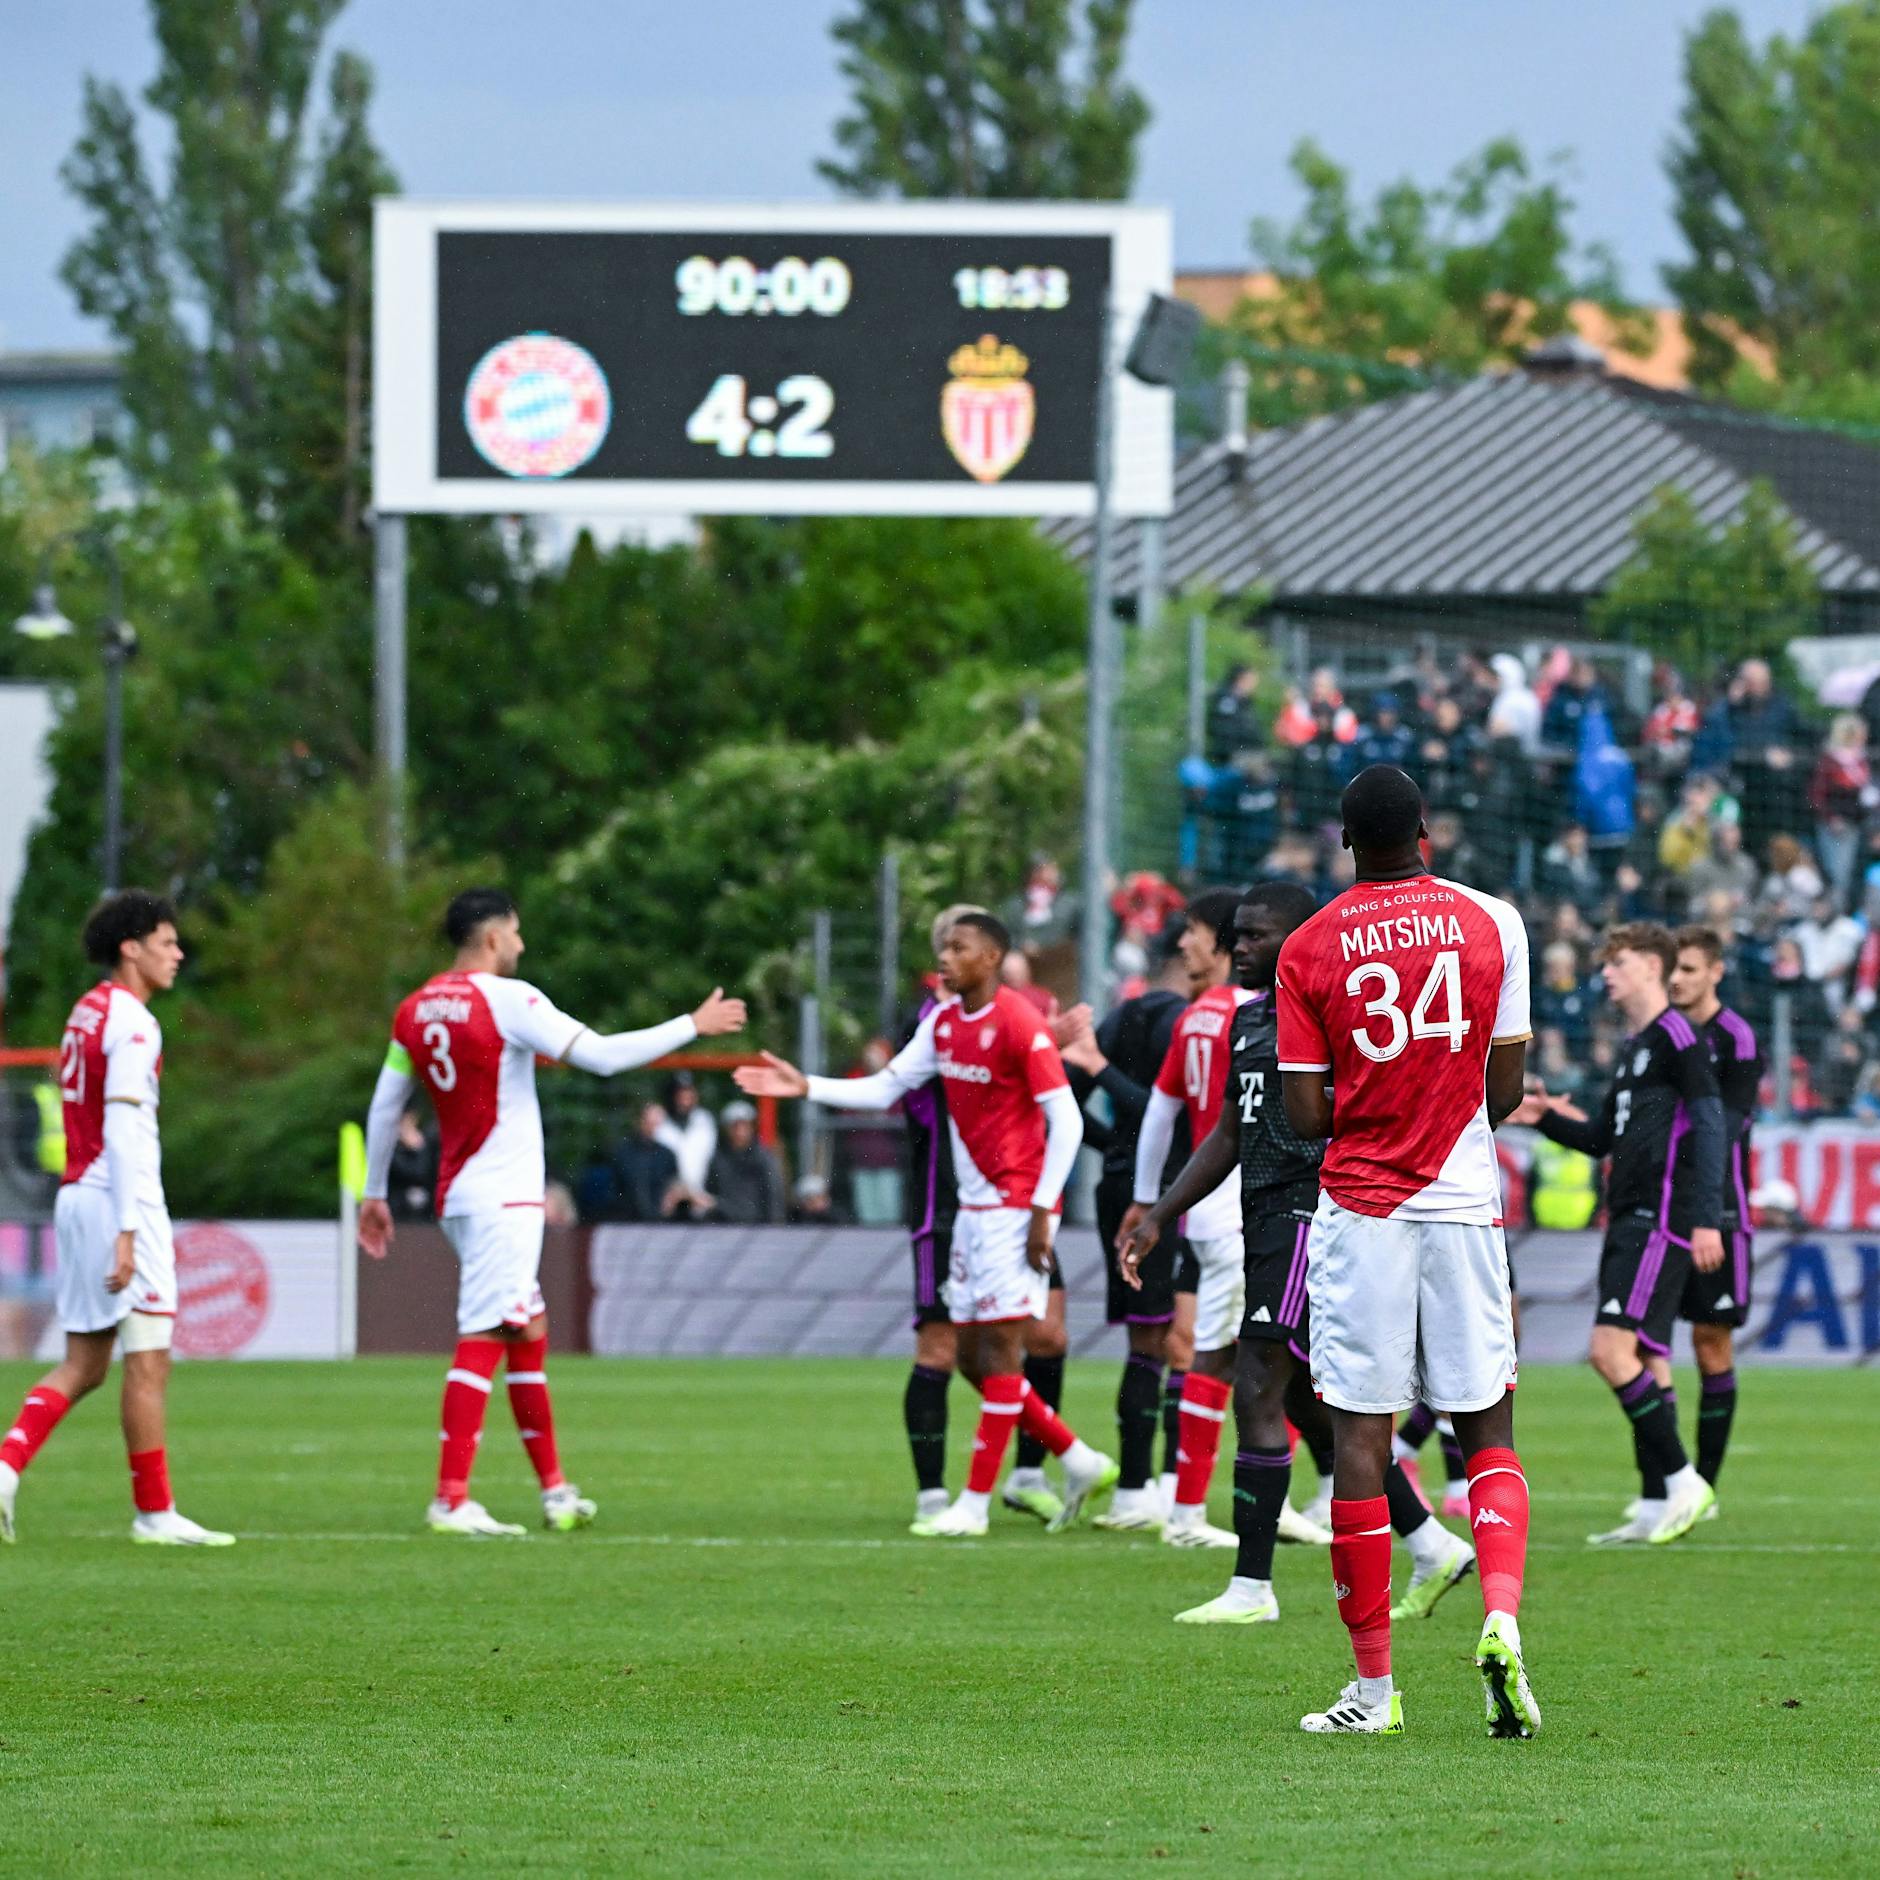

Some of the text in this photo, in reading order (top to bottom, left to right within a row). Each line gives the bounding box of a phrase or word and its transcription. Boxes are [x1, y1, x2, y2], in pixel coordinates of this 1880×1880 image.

[675, 255, 852, 316] 90:00
[685, 374, 835, 457] 4:2
[1341, 892, 1455, 918] BANG & OLUFSEN
[1345, 951, 1471, 1063] 34
[423, 1022, 457, 1092] 3
